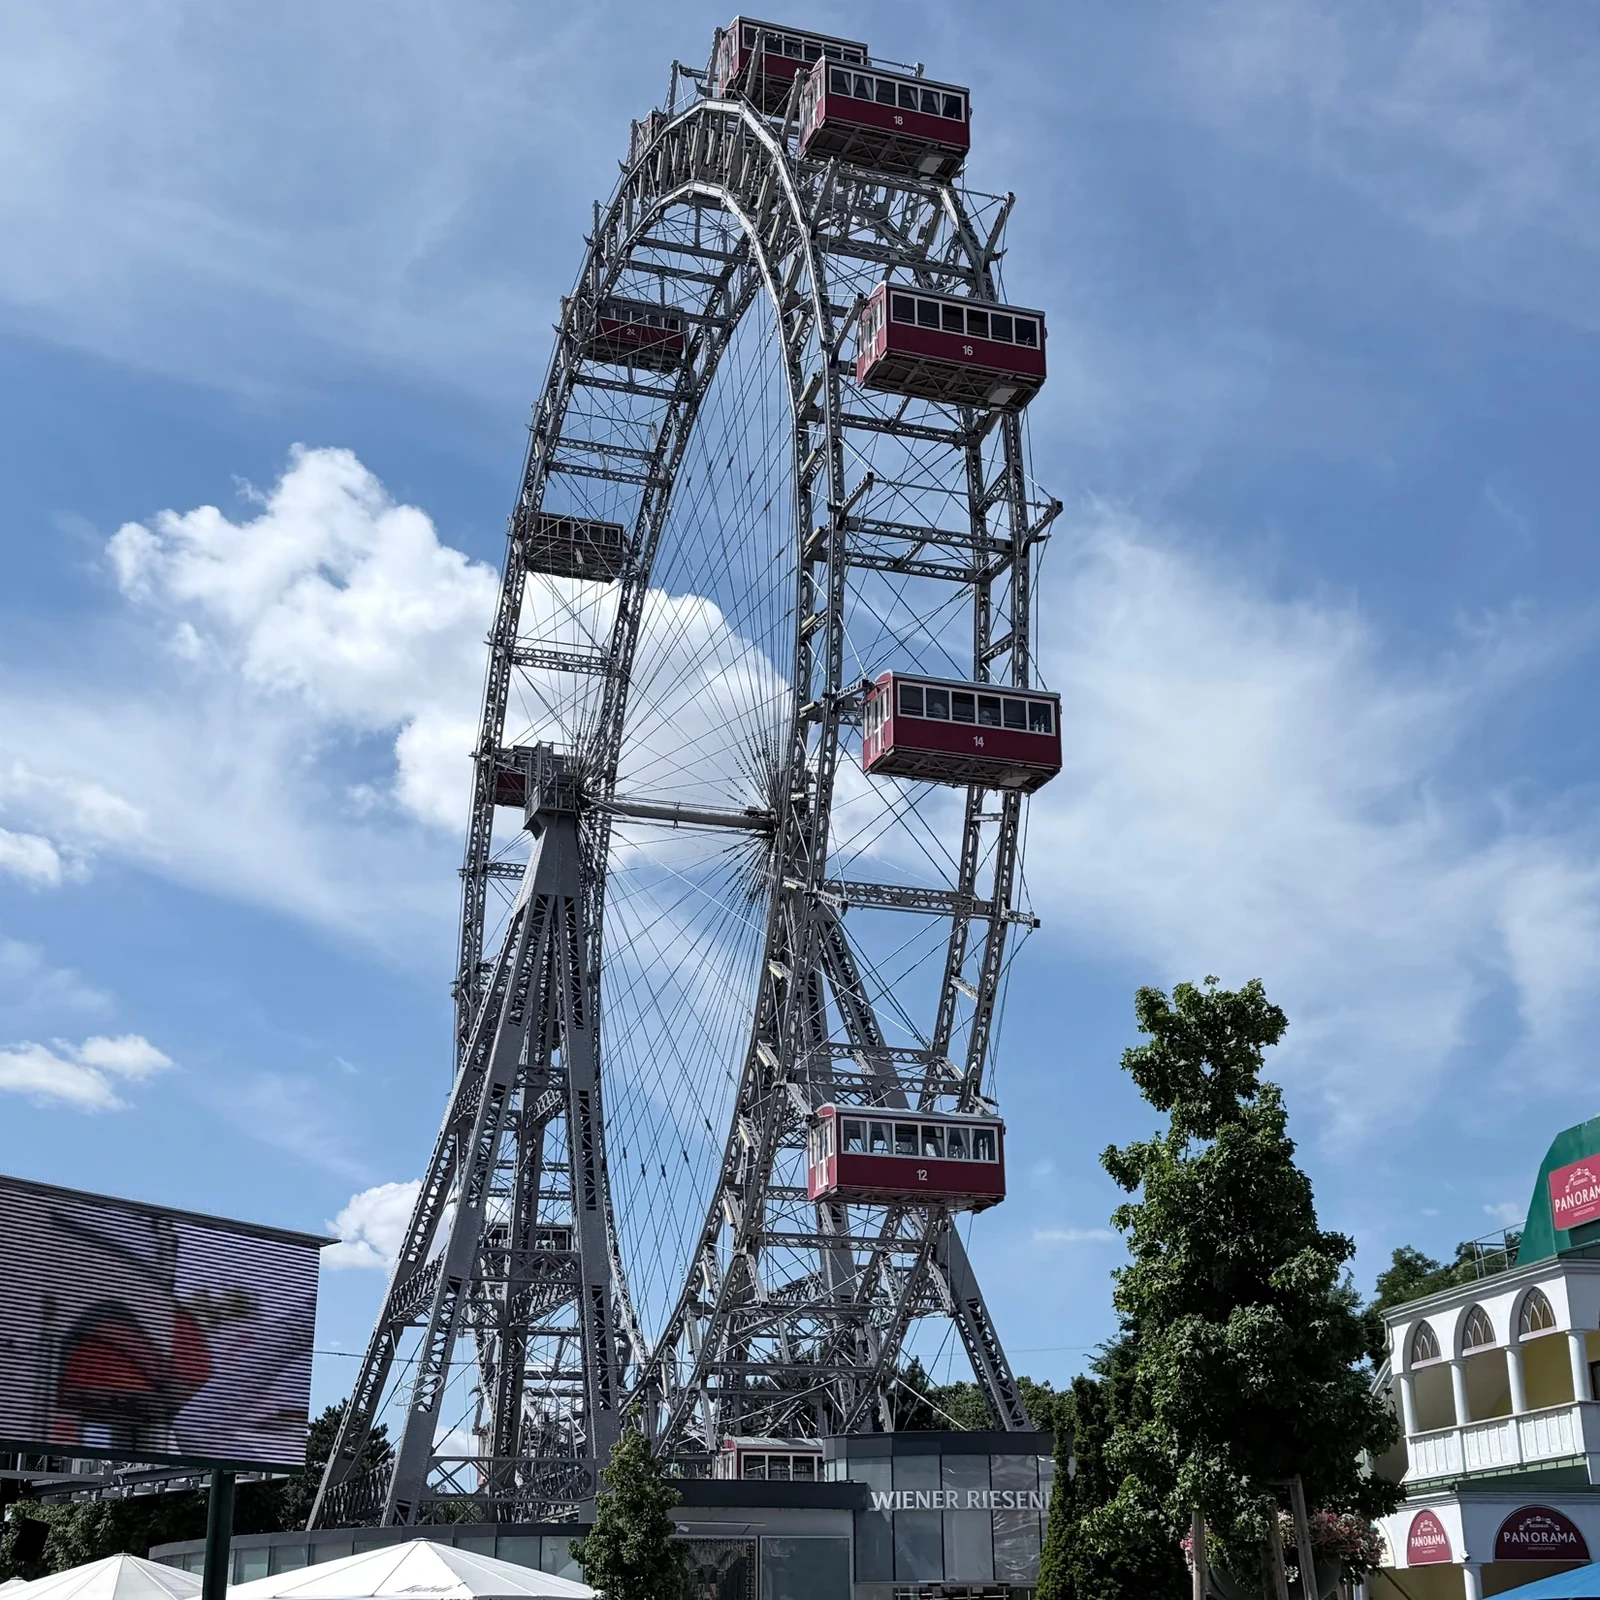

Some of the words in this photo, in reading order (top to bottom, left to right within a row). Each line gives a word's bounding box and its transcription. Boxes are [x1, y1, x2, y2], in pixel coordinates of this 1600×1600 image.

[892, 114, 904, 126] 18
[961, 344, 974, 356] 16
[972, 735, 985, 748] 14
[916, 1168, 928, 1181] 12
[870, 1491, 959, 1509] WIENER
[1411, 1534, 1446, 1547] PANORAMA
[1503, 1531, 1577, 1543] PANORAMA
